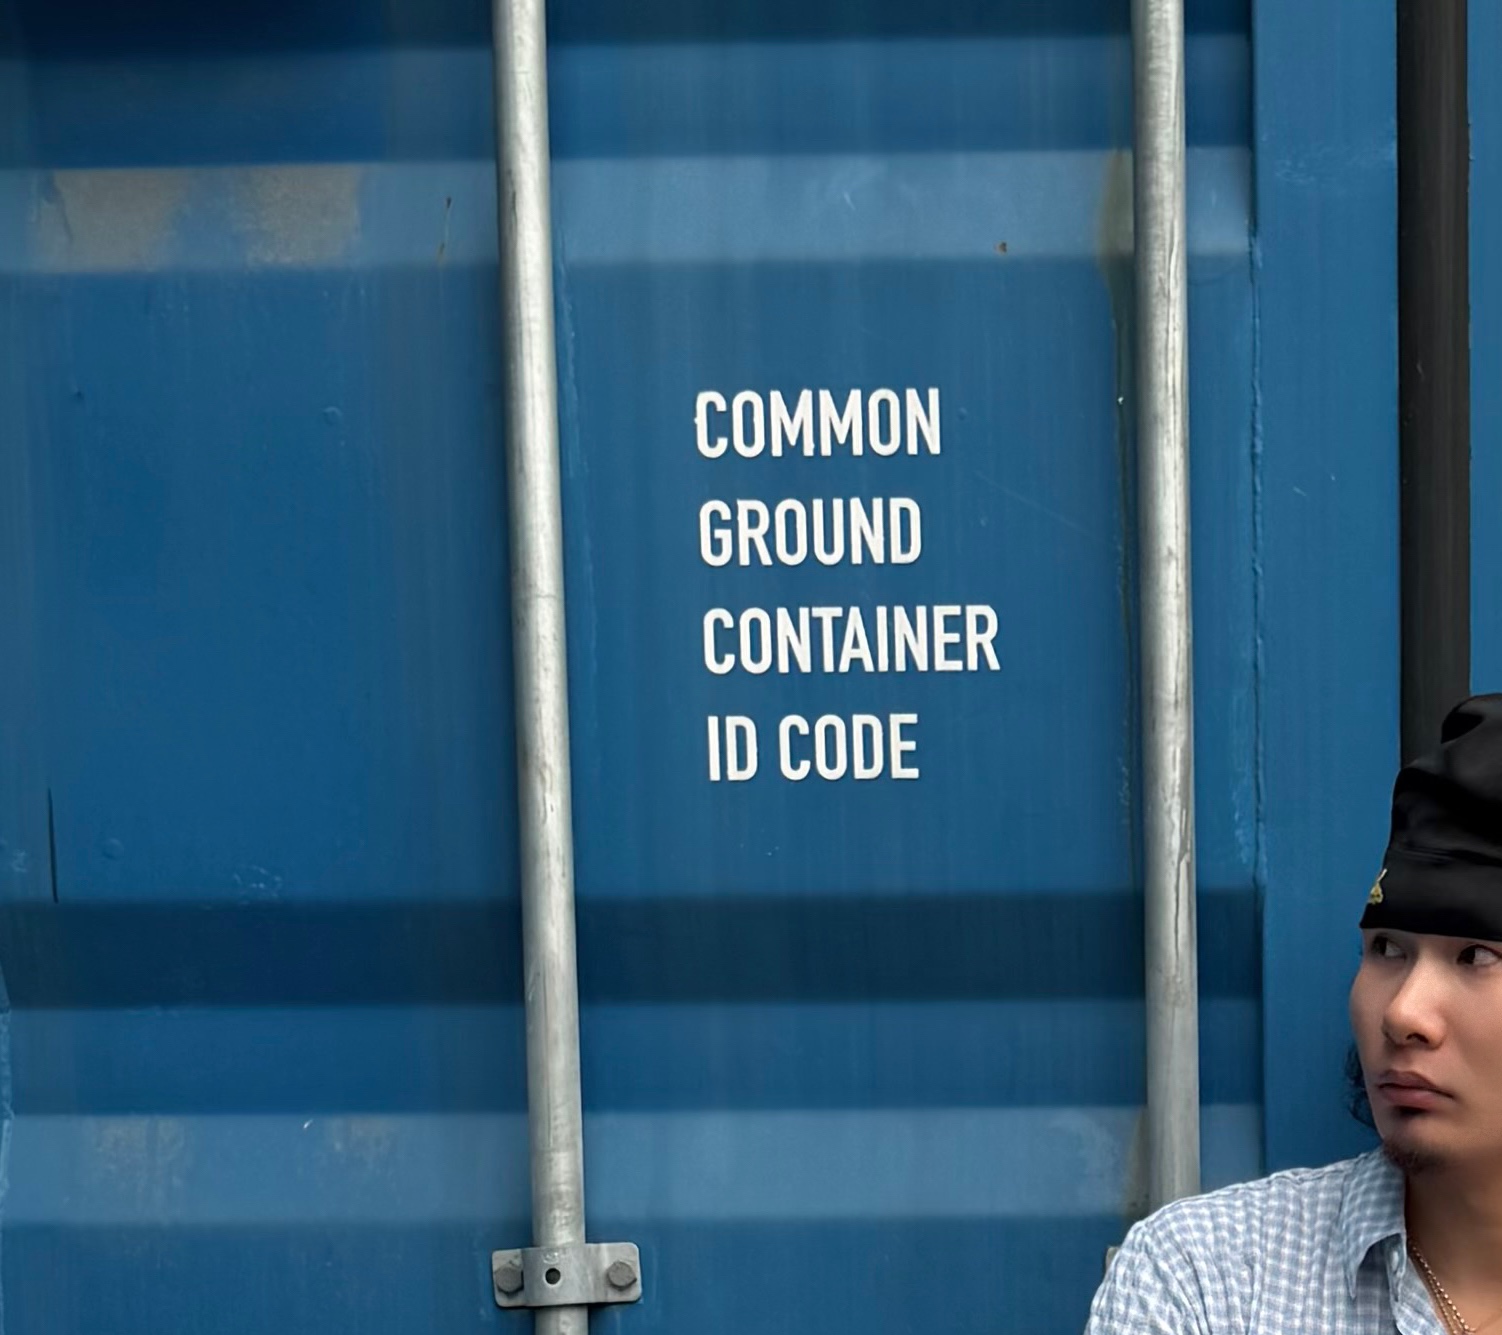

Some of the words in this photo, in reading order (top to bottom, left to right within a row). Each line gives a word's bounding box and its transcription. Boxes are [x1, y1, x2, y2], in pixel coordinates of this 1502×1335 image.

[694, 388, 941, 458] COMMON
[699, 496, 922, 566] GROUND
[703, 604, 1001, 675] CONTAINER
[707, 715, 758, 781] ID
[778, 713, 920, 781] CODE
